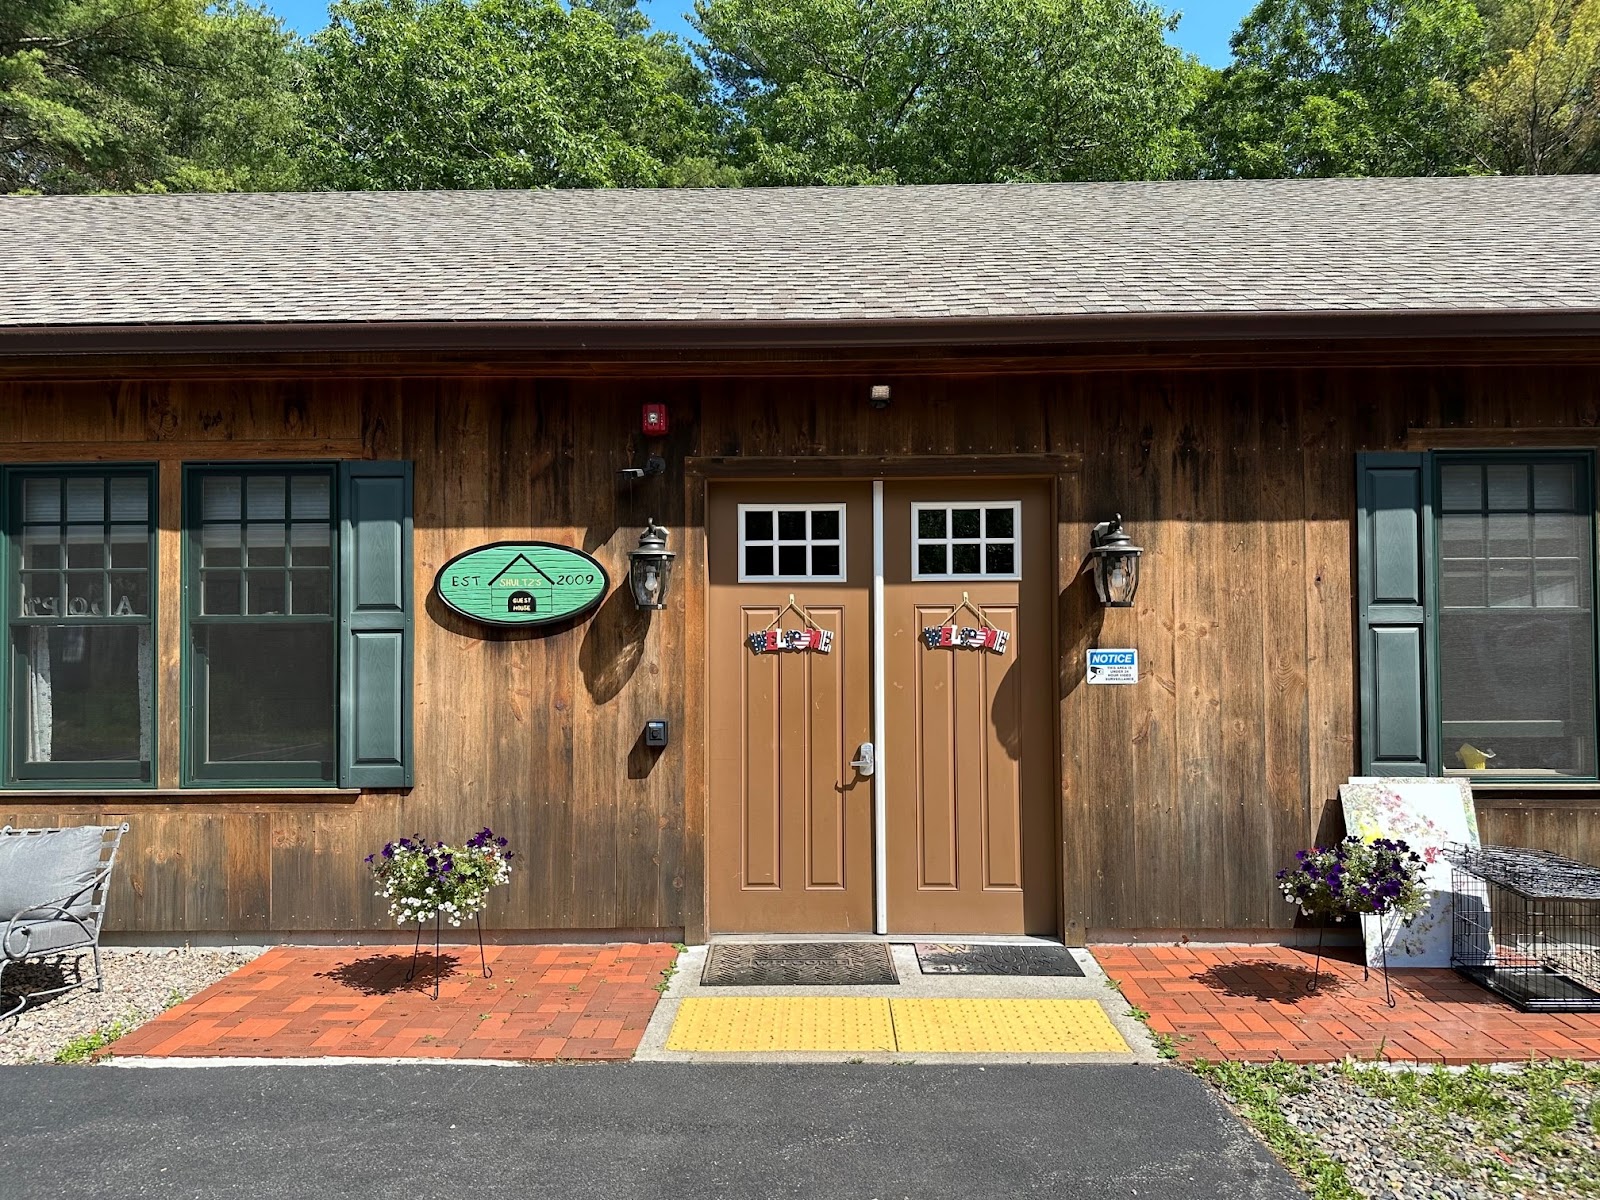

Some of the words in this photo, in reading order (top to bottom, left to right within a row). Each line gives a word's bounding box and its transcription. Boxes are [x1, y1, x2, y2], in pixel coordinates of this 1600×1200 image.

[452, 576, 481, 587] EST
[556, 574, 594, 586] 2009
[500, 578, 542, 587] SHULTZ'S
[1092, 654, 1133, 664] NOTICE
